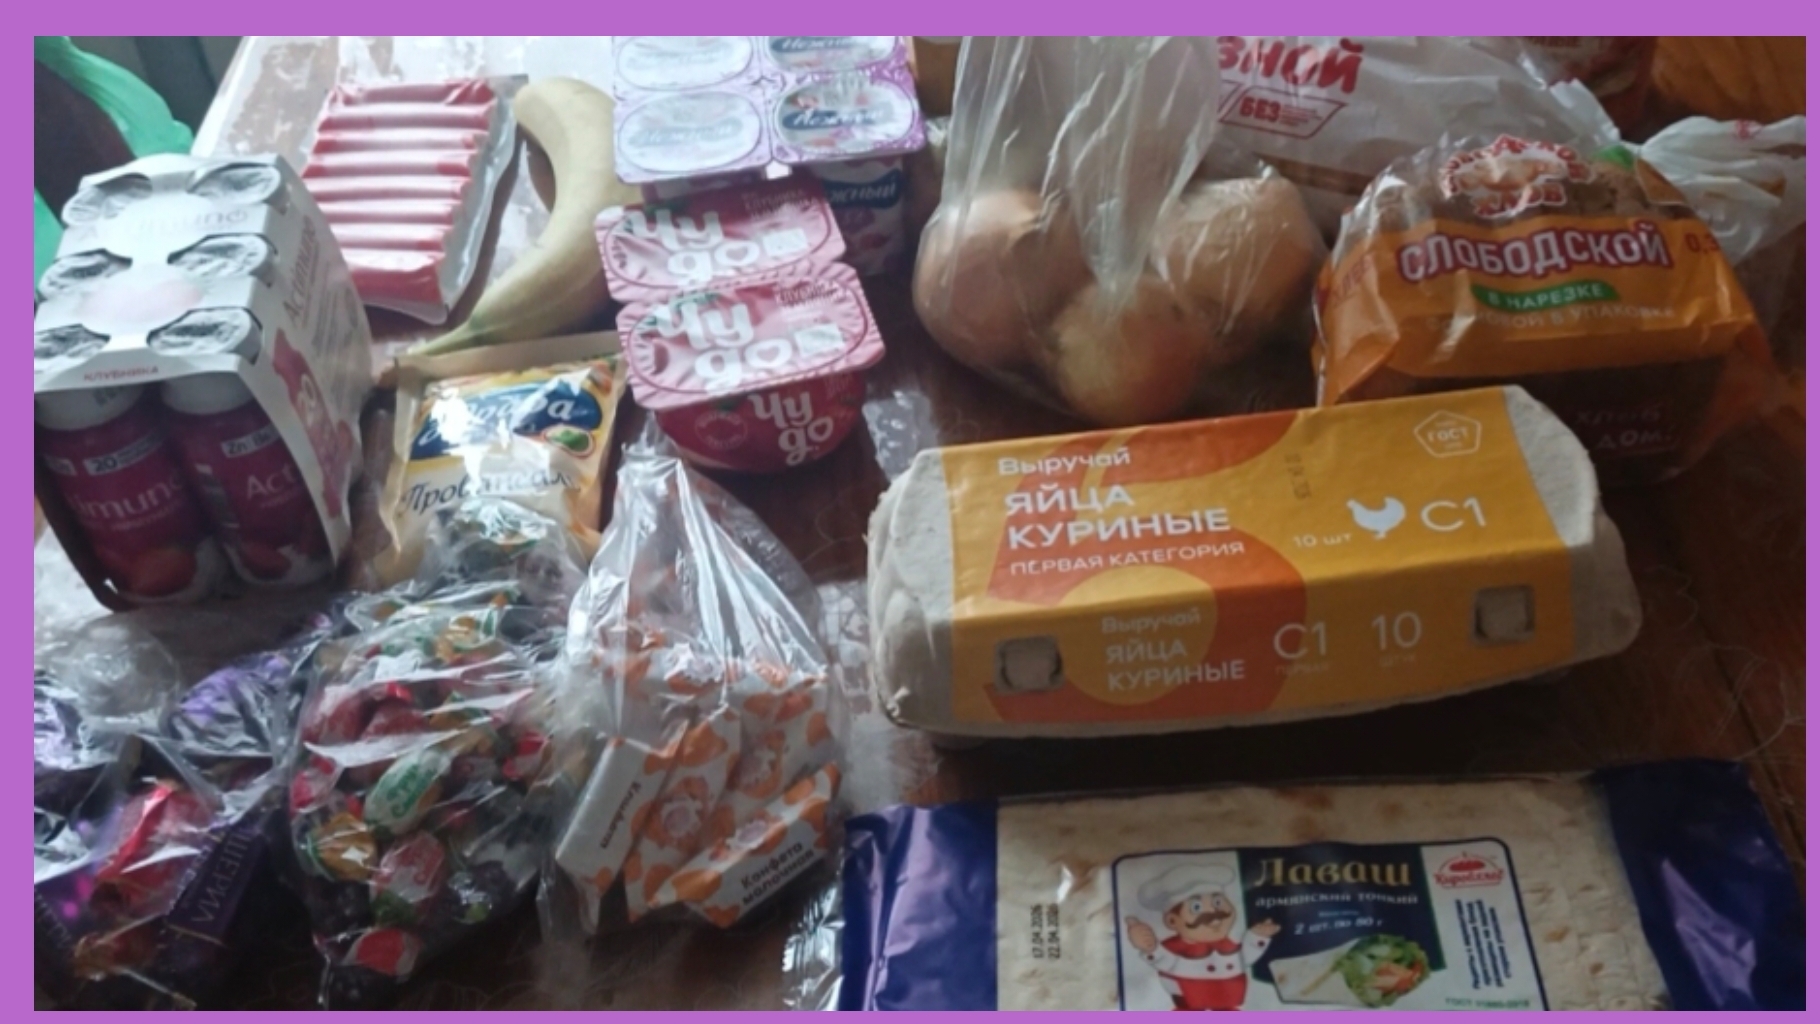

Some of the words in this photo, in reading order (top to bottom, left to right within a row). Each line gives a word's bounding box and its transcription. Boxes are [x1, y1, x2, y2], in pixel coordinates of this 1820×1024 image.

[1240, 97, 1280, 123] БЕЗ
[1399, 224, 1670, 282] СЛОБОДСКОЙ
[1506, 282, 1606, 309] НАРЕЗКЕ
[1427, 427, 1469, 443] ГОСТ
[999, 447, 1132, 476] Выручай
[1004, 484, 1135, 515] ЯЙЦА
[1008, 508, 1231, 550] КУРИНЫЕ
[1010, 554, 1103, 576] ПЕРВАЯ
[1108, 541, 1245, 568] КАТЕГОРИЯ
[1101, 607, 1201, 635] Выручай
[1371, 611, 1423, 651] 10
[1106, 640, 1187, 665] ЯЙЦА
[1108, 659, 1246, 692] КУРИНЫЕ
[1253, 857, 1412, 888] Лаваш
[1294, 922, 1305, 936] 2
